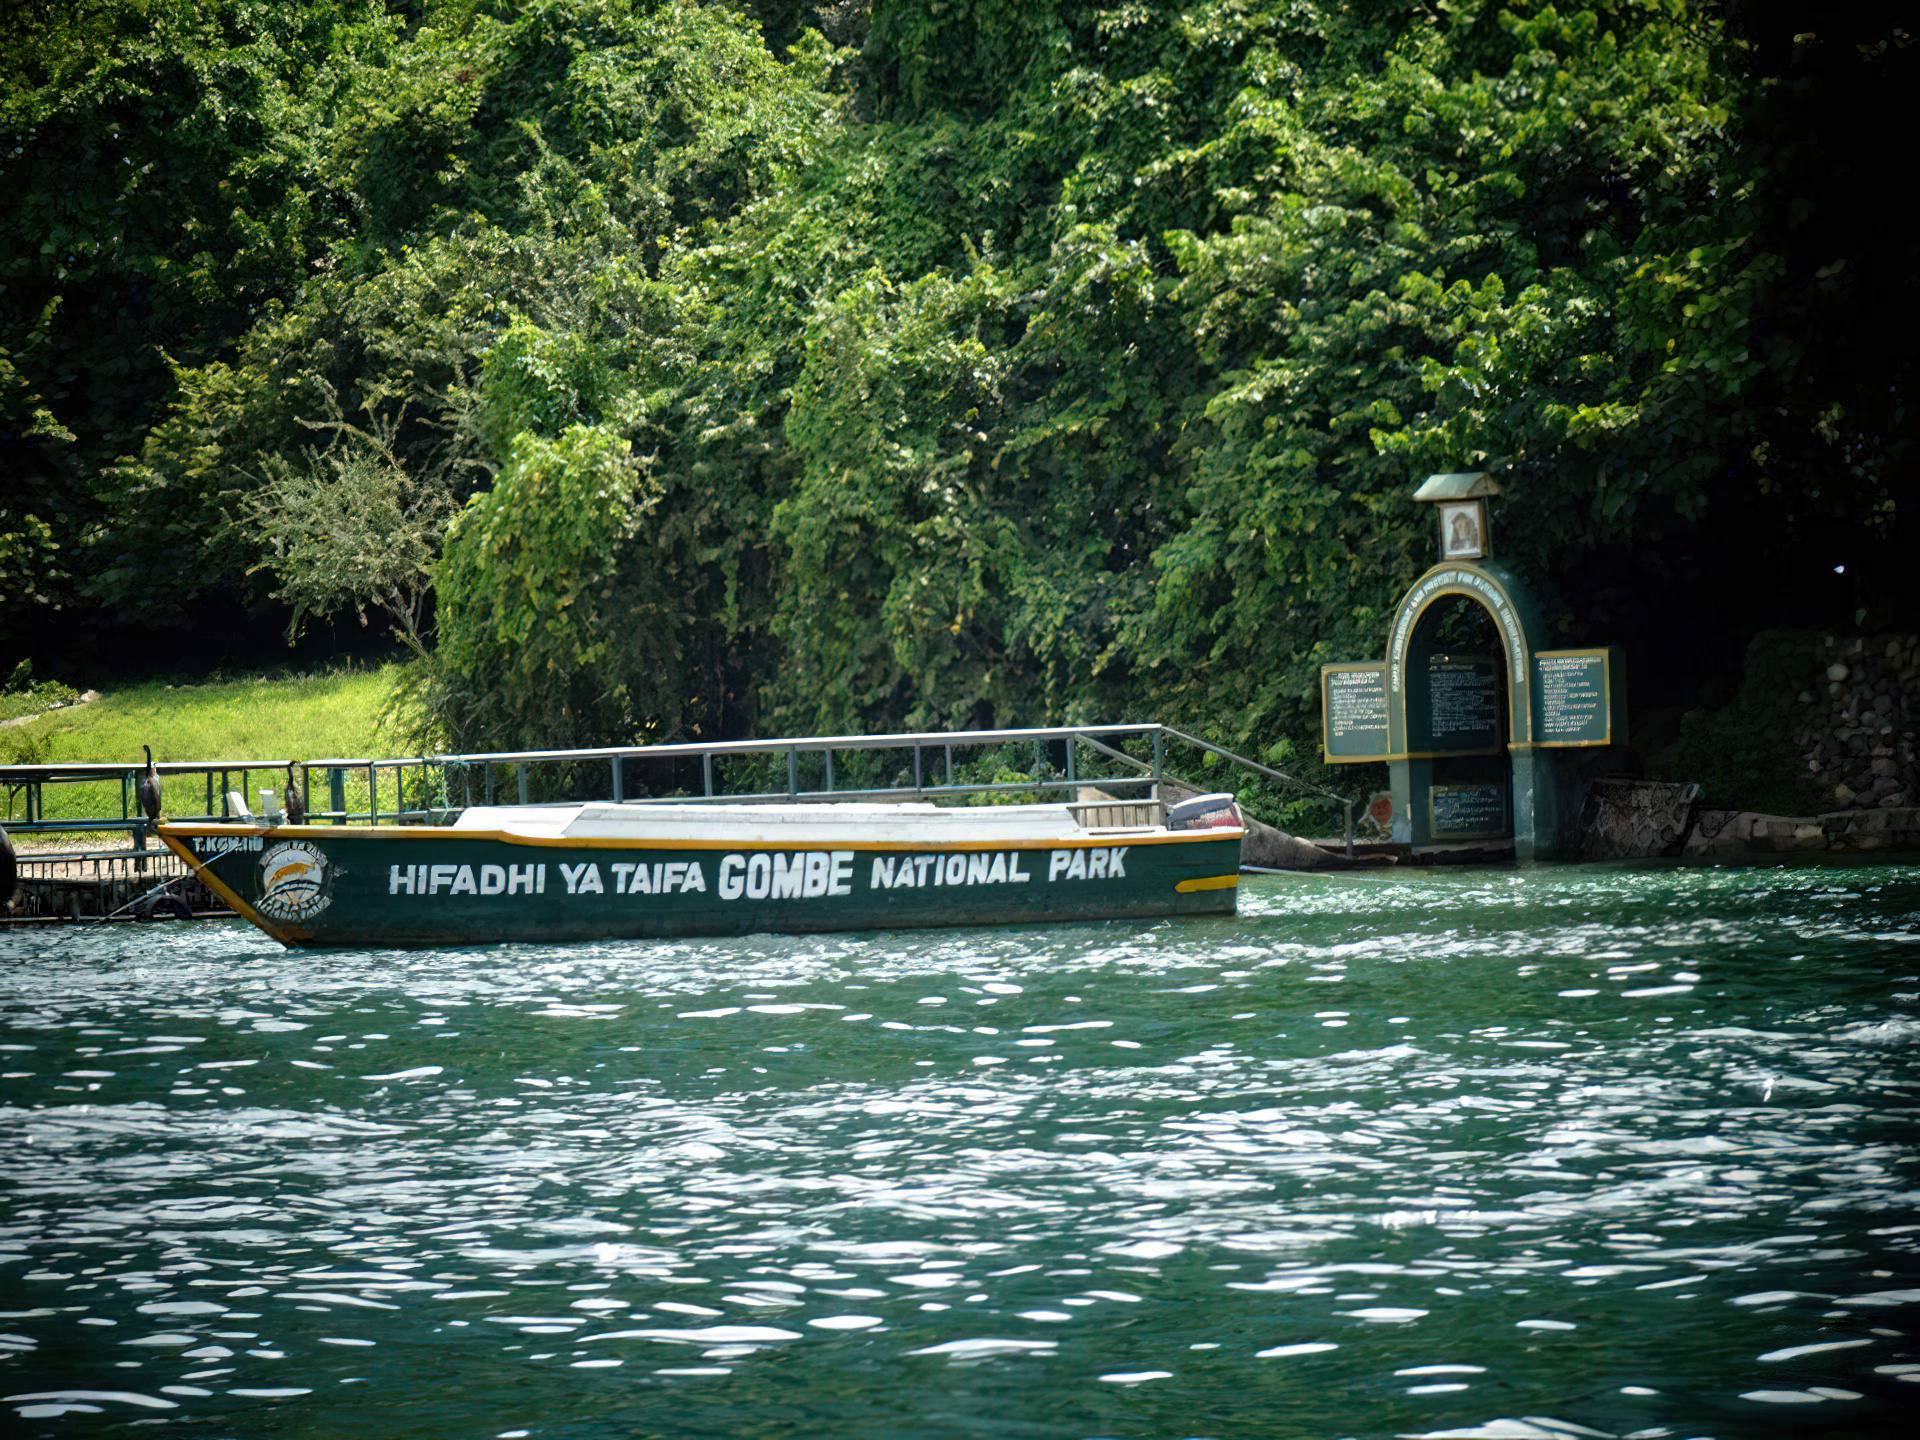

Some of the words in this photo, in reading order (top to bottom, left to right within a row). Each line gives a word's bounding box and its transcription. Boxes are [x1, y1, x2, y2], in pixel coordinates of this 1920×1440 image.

[389, 863, 546, 895] HIFADHI
[559, 863, 604, 894] YA
[611, 861, 707, 894] TAIFA
[718, 850, 855, 900] GOMBE
[870, 852, 1031, 889] NATIONAL
[1048, 847, 1130, 882] PARK
